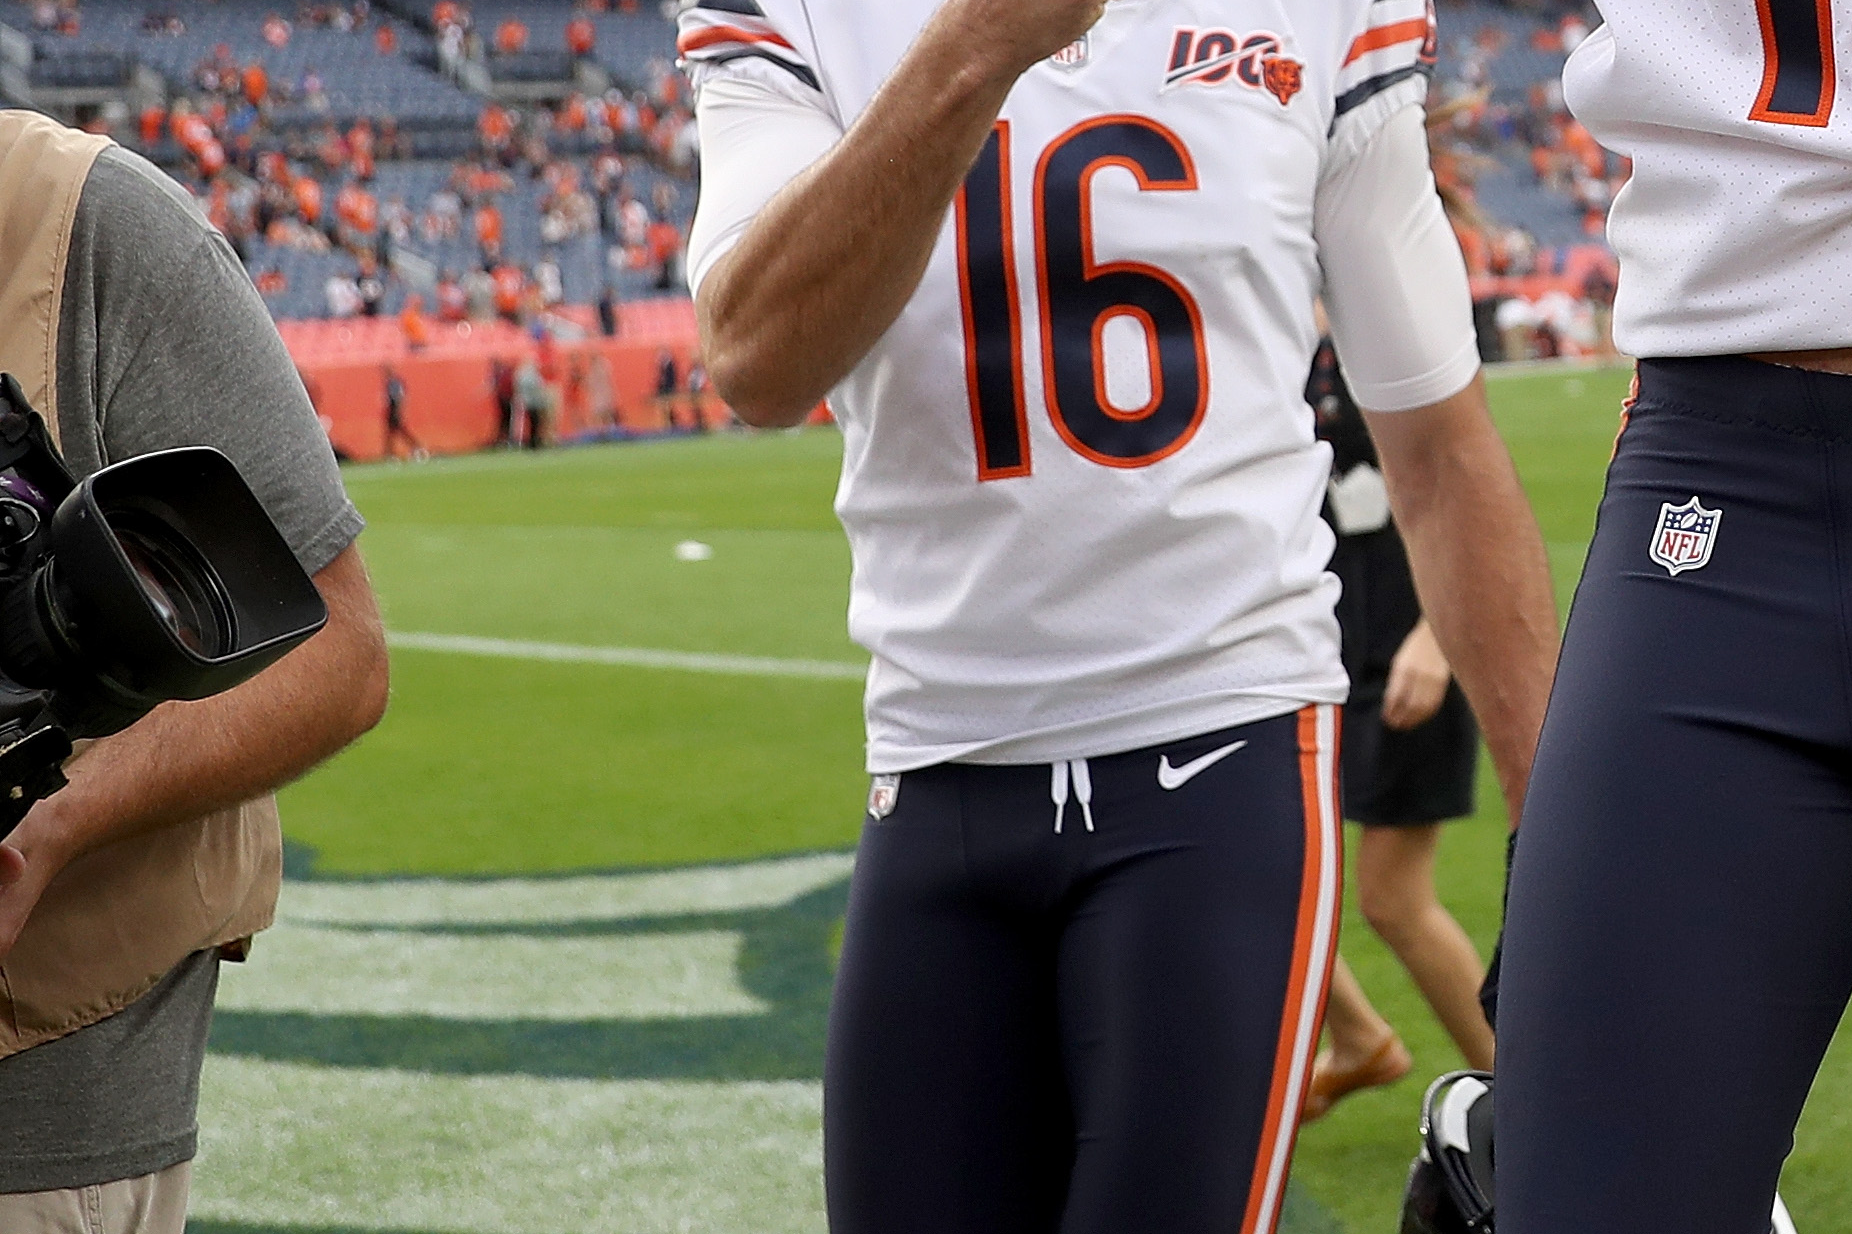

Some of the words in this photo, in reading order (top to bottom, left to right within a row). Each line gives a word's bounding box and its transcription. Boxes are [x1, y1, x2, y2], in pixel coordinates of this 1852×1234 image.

[1165, 28, 1281, 89] 100
[953, 113, 1210, 482] 16
[1660, 530, 1701, 562] NFL
